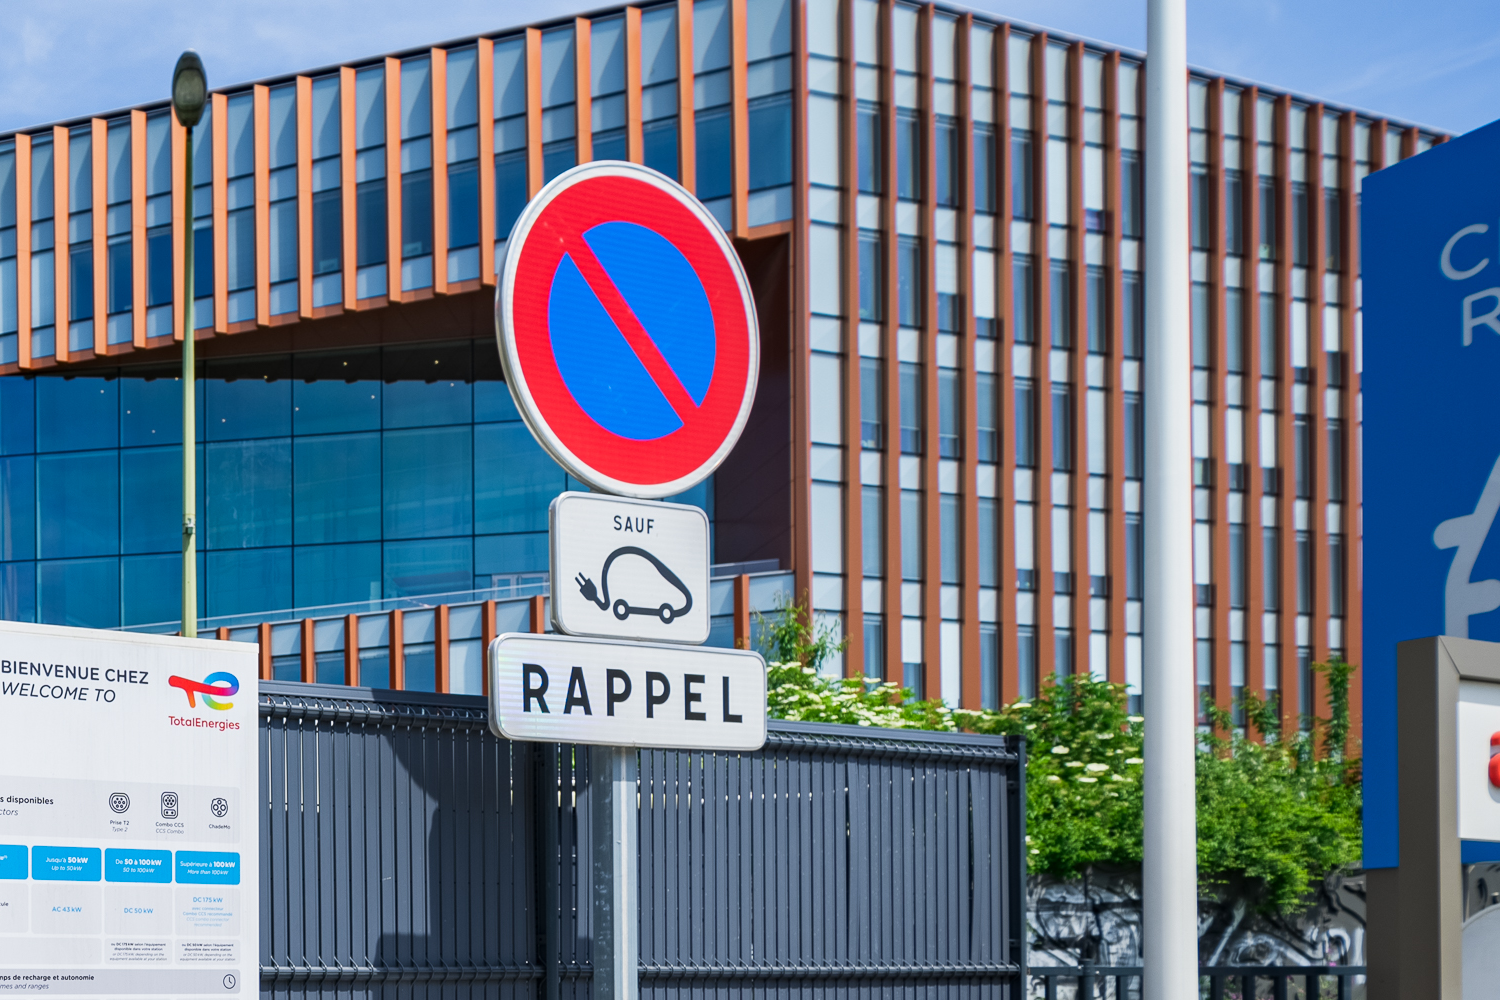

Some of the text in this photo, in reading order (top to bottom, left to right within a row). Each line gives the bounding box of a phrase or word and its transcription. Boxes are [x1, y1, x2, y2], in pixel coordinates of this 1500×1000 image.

[1441, 223, 1500, 281] C
[614, 515, 655, 534] SAUF
[1, 660, 149, 684] BIENVENUE CHEZ
[1, 681, 116, 702] WELCOME TO
[523, 663, 742, 723] RAPPEL
[168, 716, 240, 731] TotalEnergies
[6, 796, 53, 804] disponibles
